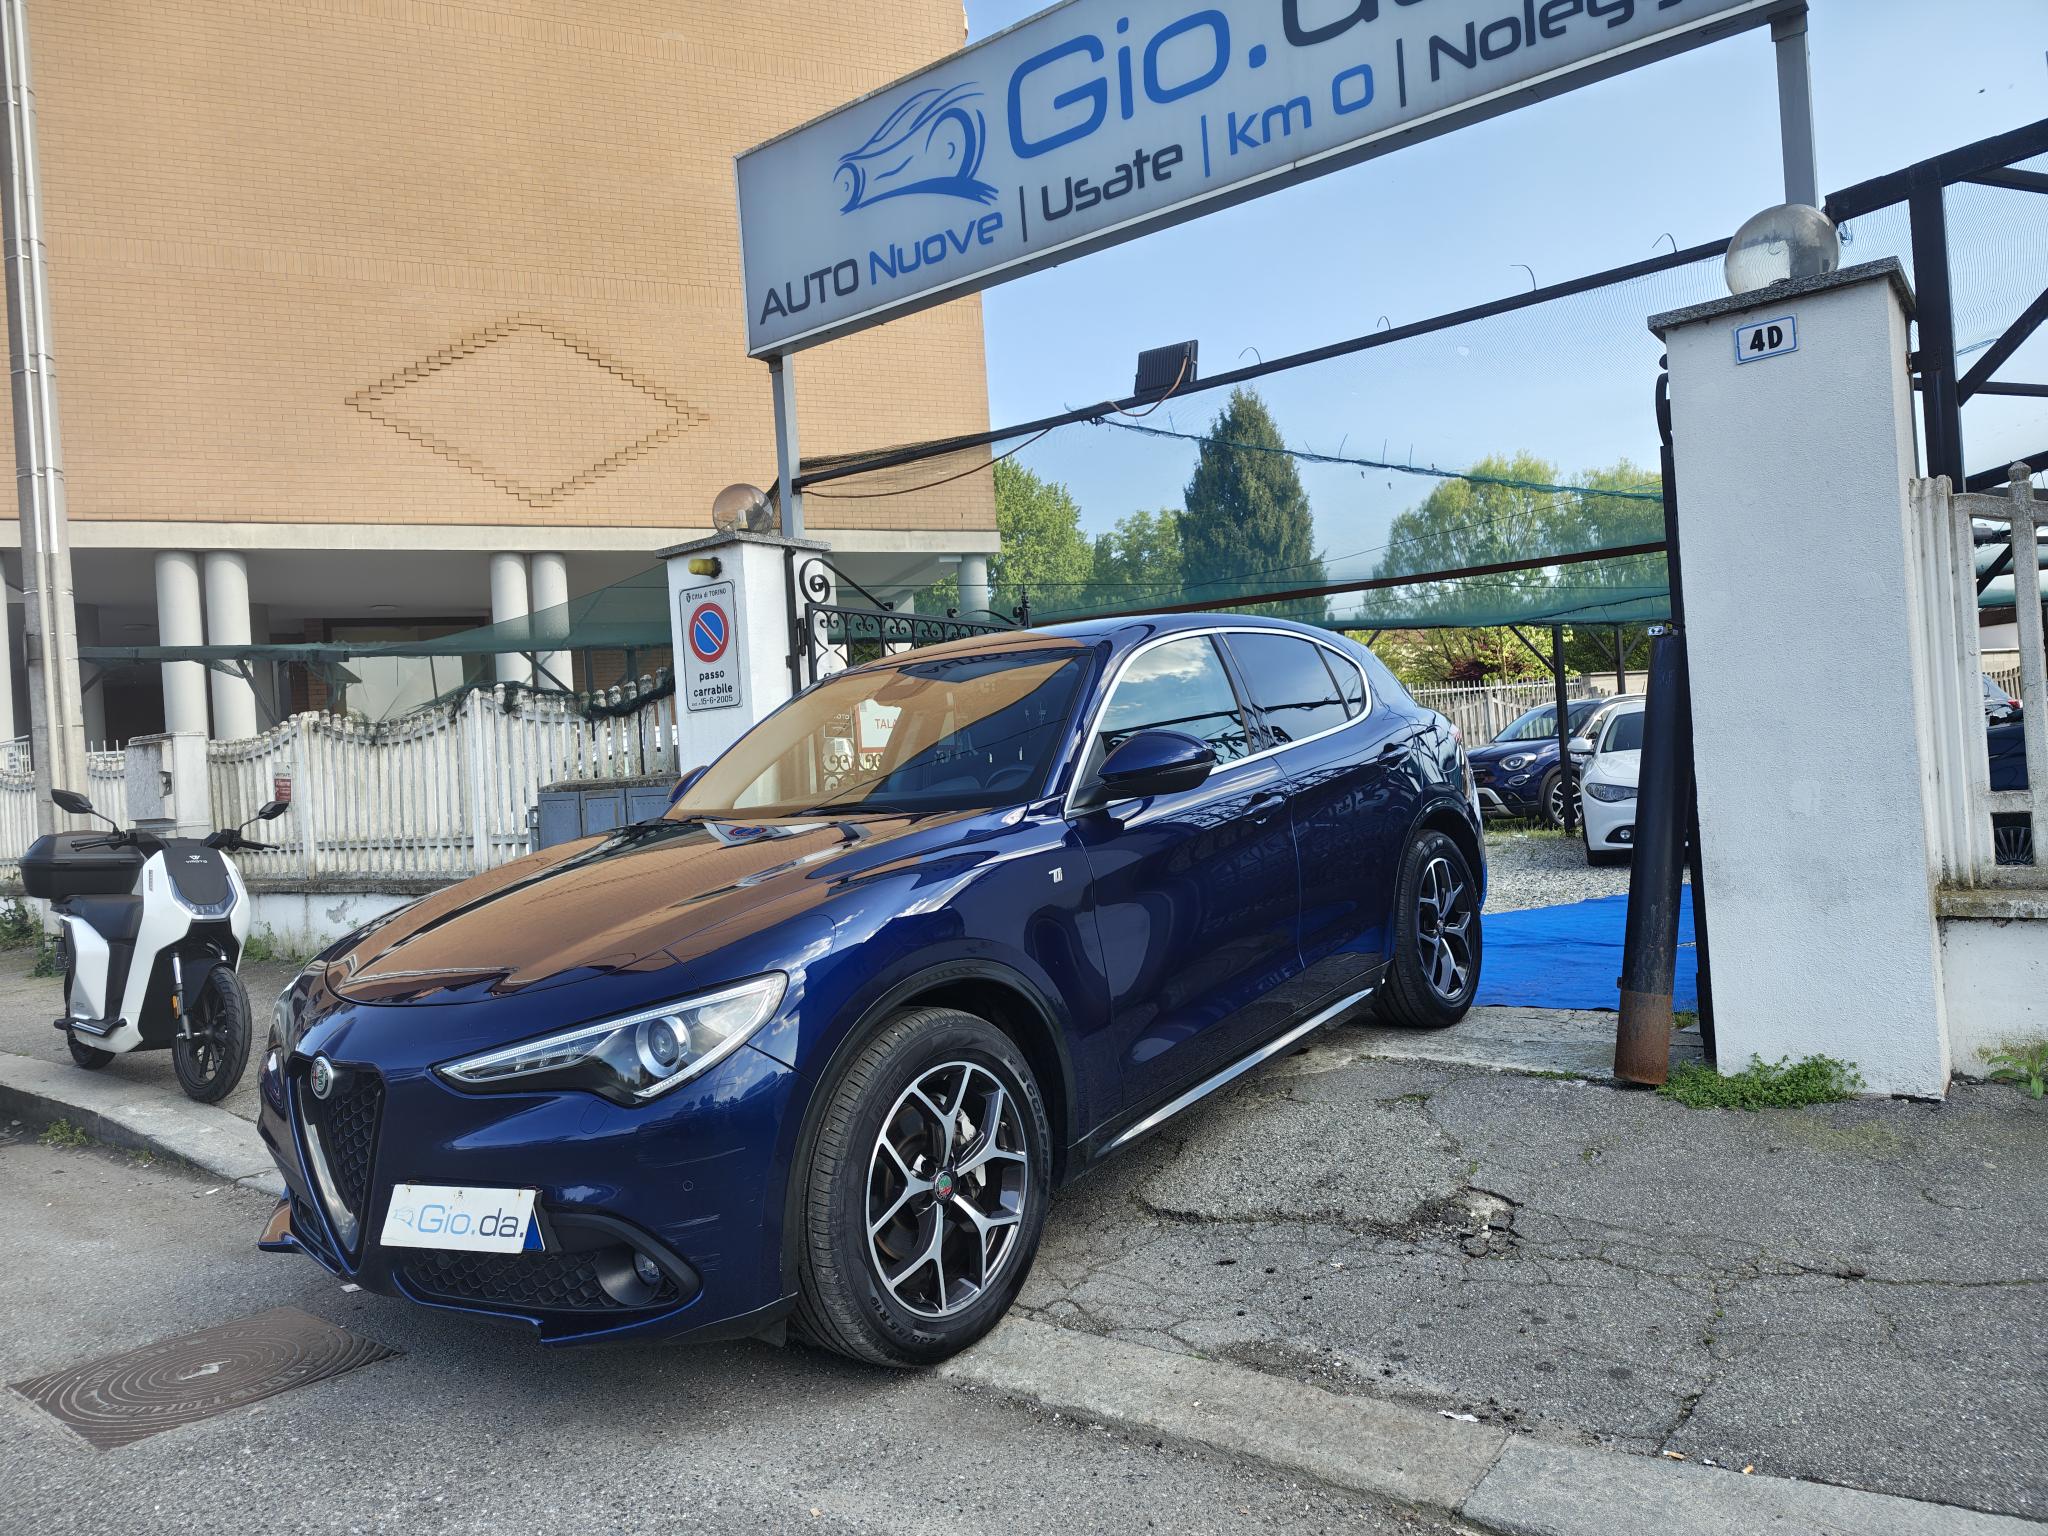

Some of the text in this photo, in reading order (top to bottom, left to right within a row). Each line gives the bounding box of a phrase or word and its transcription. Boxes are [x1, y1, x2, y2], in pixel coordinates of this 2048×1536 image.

[759, 258, 860, 325] AUTO
[868, 211, 1003, 285] Nuove
[1040, 143, 1184, 221] Usate
[1228, 94, 1312, 156] km
[1749, 325, 1784, 352] 4D
[699, 670, 725, 682] passo
[693, 683, 733, 698] carrabile
